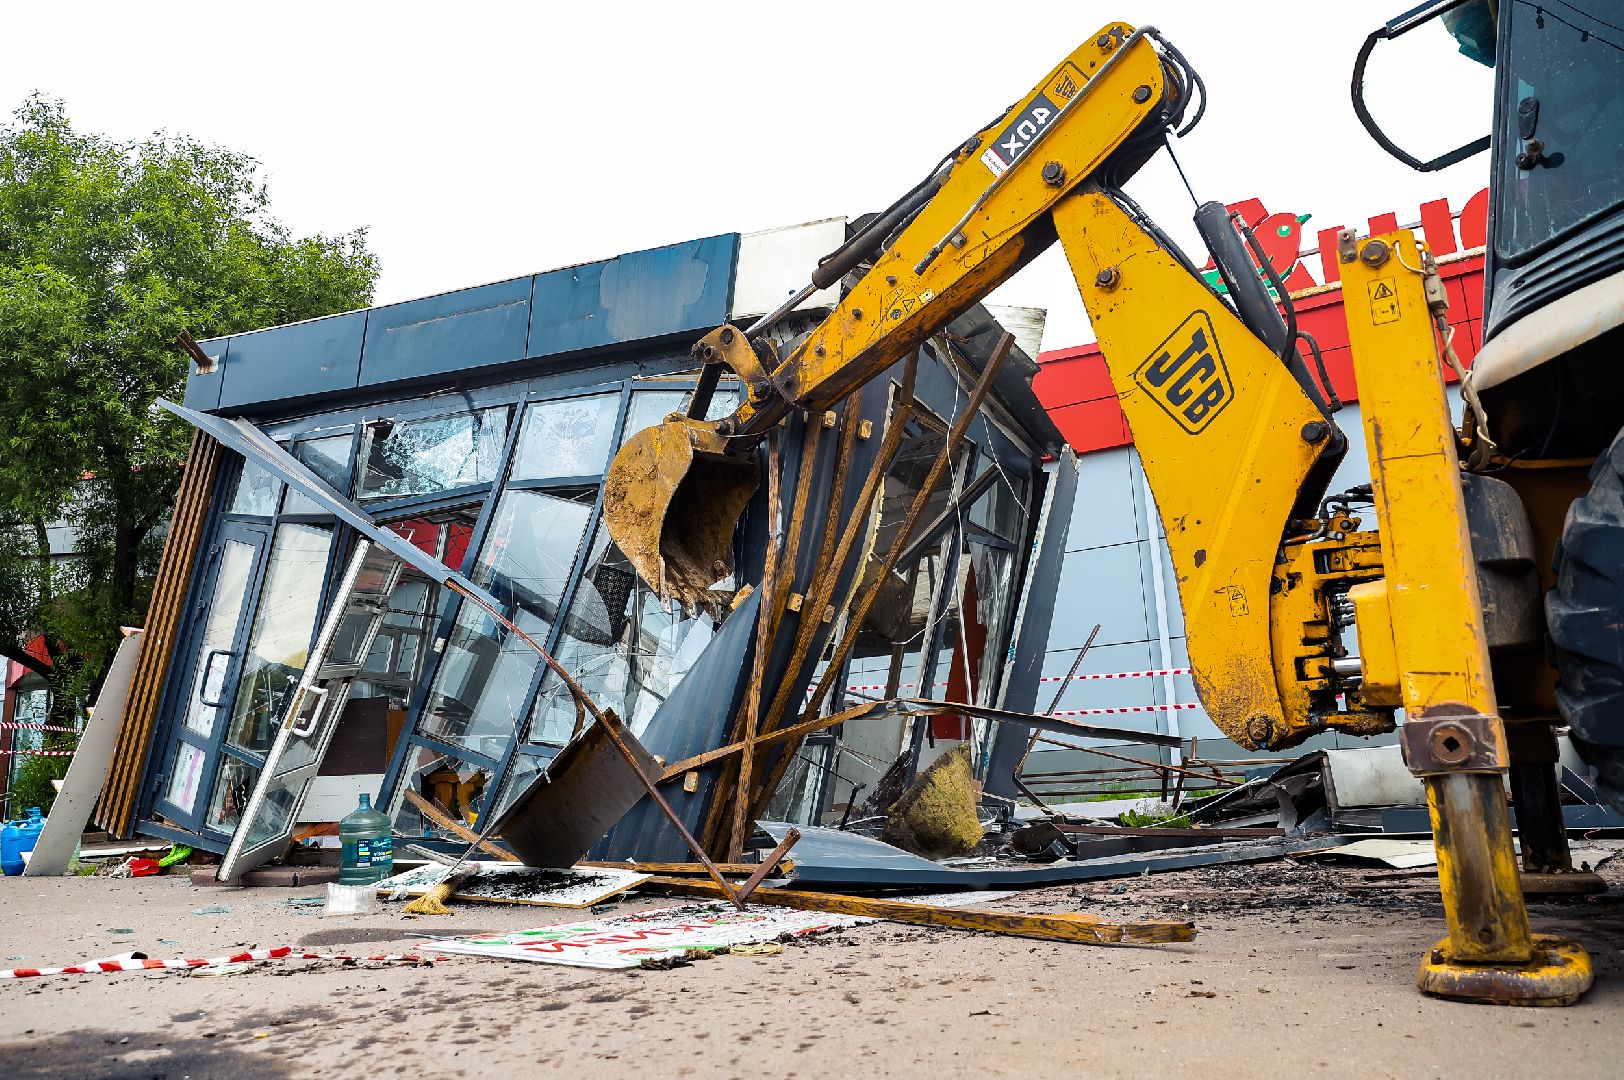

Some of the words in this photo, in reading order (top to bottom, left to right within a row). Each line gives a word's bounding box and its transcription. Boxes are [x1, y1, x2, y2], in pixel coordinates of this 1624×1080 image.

[1055, 74, 1075, 99] JCB
[1001, 106, 1051, 158] 4CX
[1145, 327, 1225, 424] JCB
